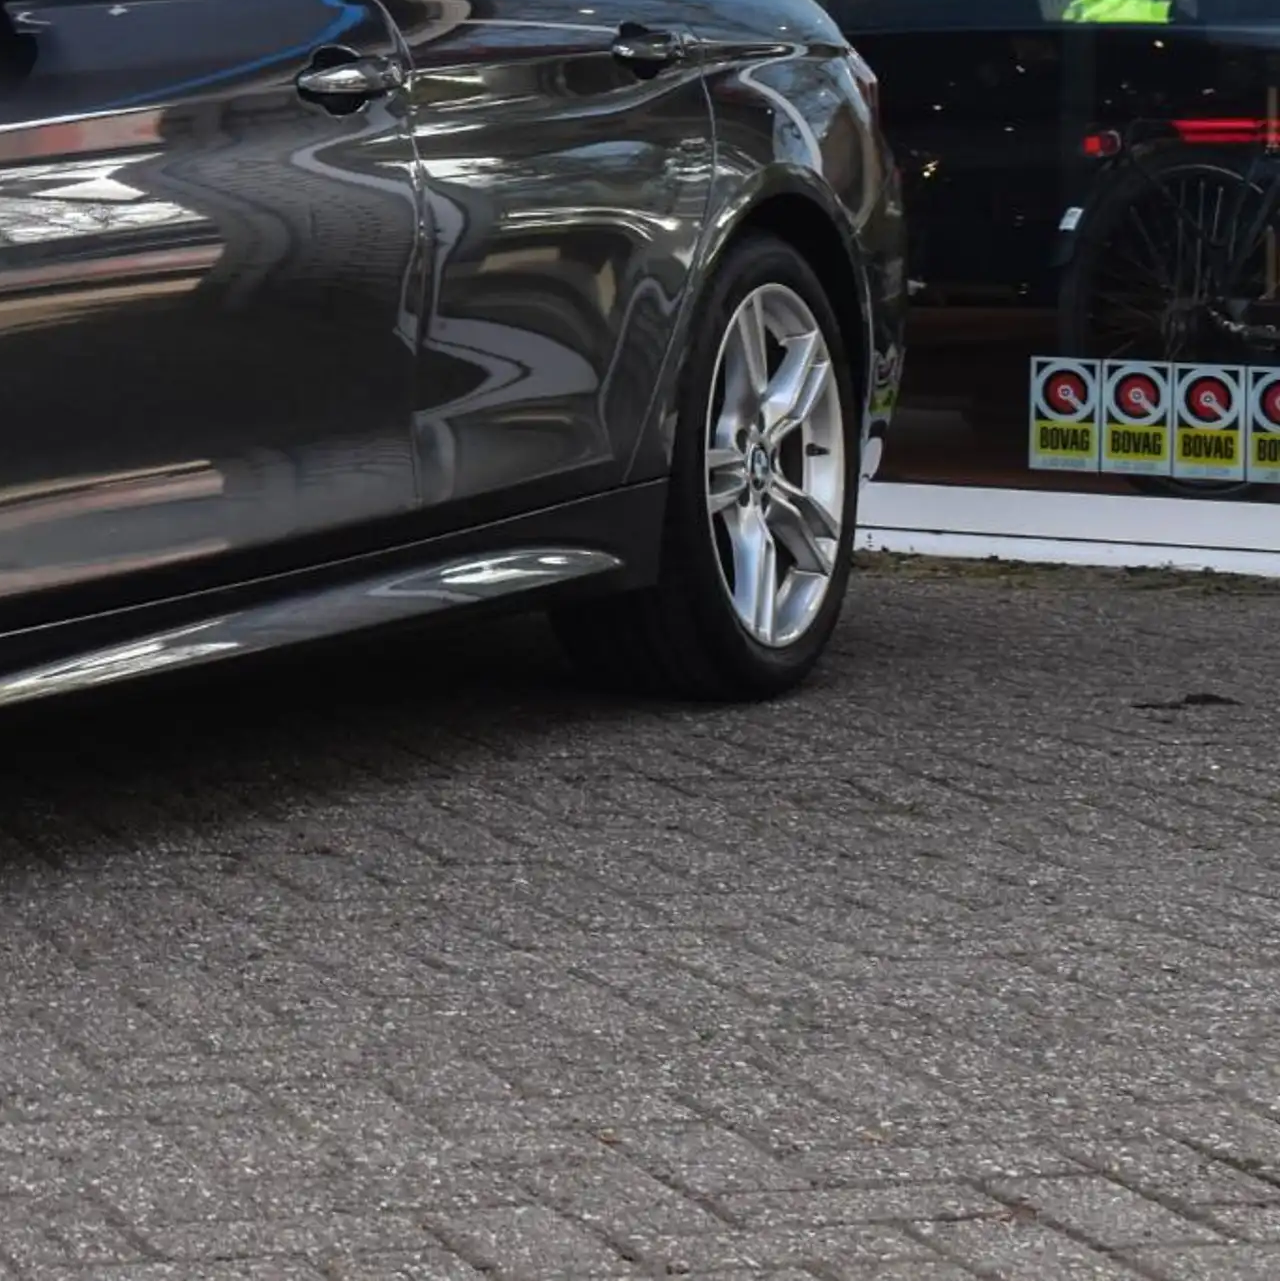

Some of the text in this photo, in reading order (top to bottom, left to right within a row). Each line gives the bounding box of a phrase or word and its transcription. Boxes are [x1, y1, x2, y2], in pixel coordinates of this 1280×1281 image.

[1040, 426, 1091, 452] BOVAG
[1111, 430, 1162, 456] BOVAG
[1182, 433, 1234, 460] BOVAG
